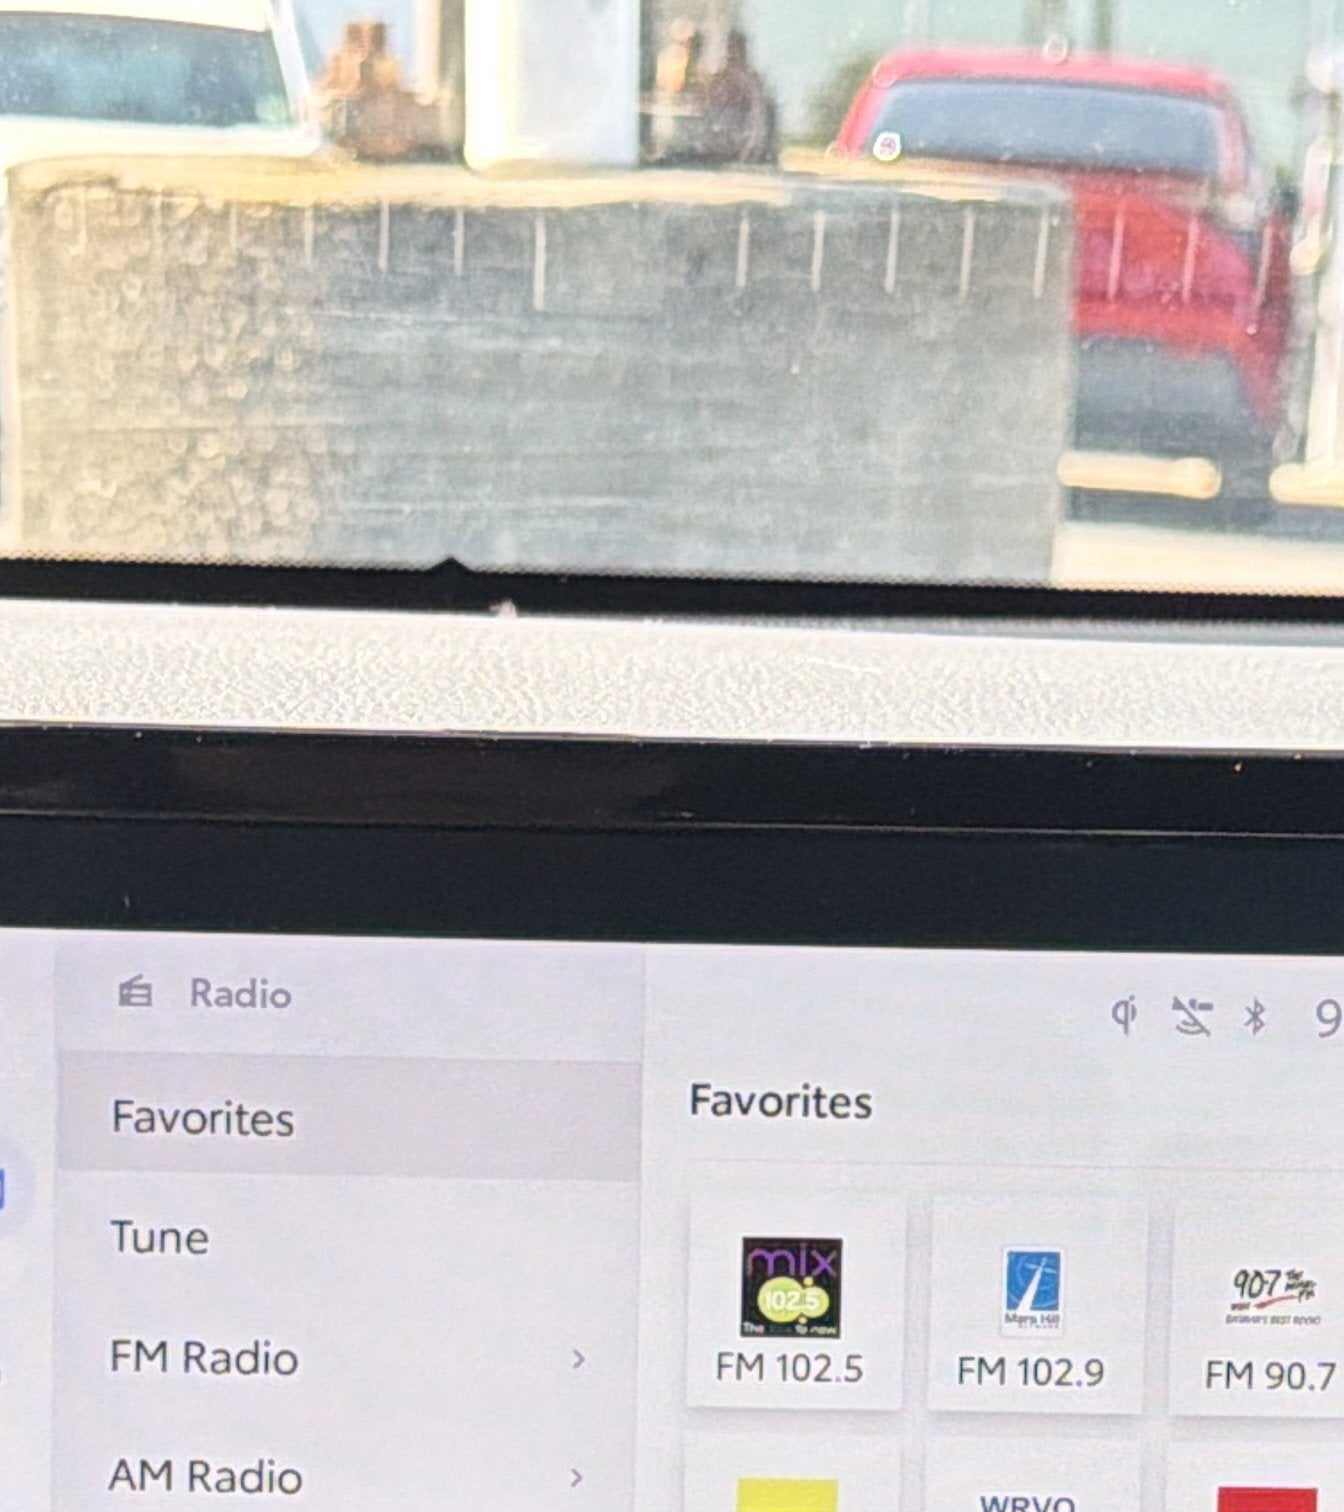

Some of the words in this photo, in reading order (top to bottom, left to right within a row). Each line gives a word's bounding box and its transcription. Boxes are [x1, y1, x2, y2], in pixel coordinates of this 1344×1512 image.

[190, 977, 292, 1009] Radio
[113, 1099, 294, 1137] Favorites
[691, 1082, 872, 1120] Favorites
[110, 1219, 209, 1255] Tune
[747, 1242, 837, 1277] mix
[111, 1339, 168, 1373] FM
[183, 1339, 299, 1376] Radio
[716, 1351, 764, 1381] FM
[776, 1353, 864, 1383] 102.5
[958, 1356, 1006, 1386] FM
[1017, 1357, 1104, 1387] 102.9
[1206, 1360, 1253, 1390] FM
[1265, 1361, 1337, 1391] 90.7
[108, 1458, 173, 1492] AM
[188, 1458, 303, 1495] Radio
